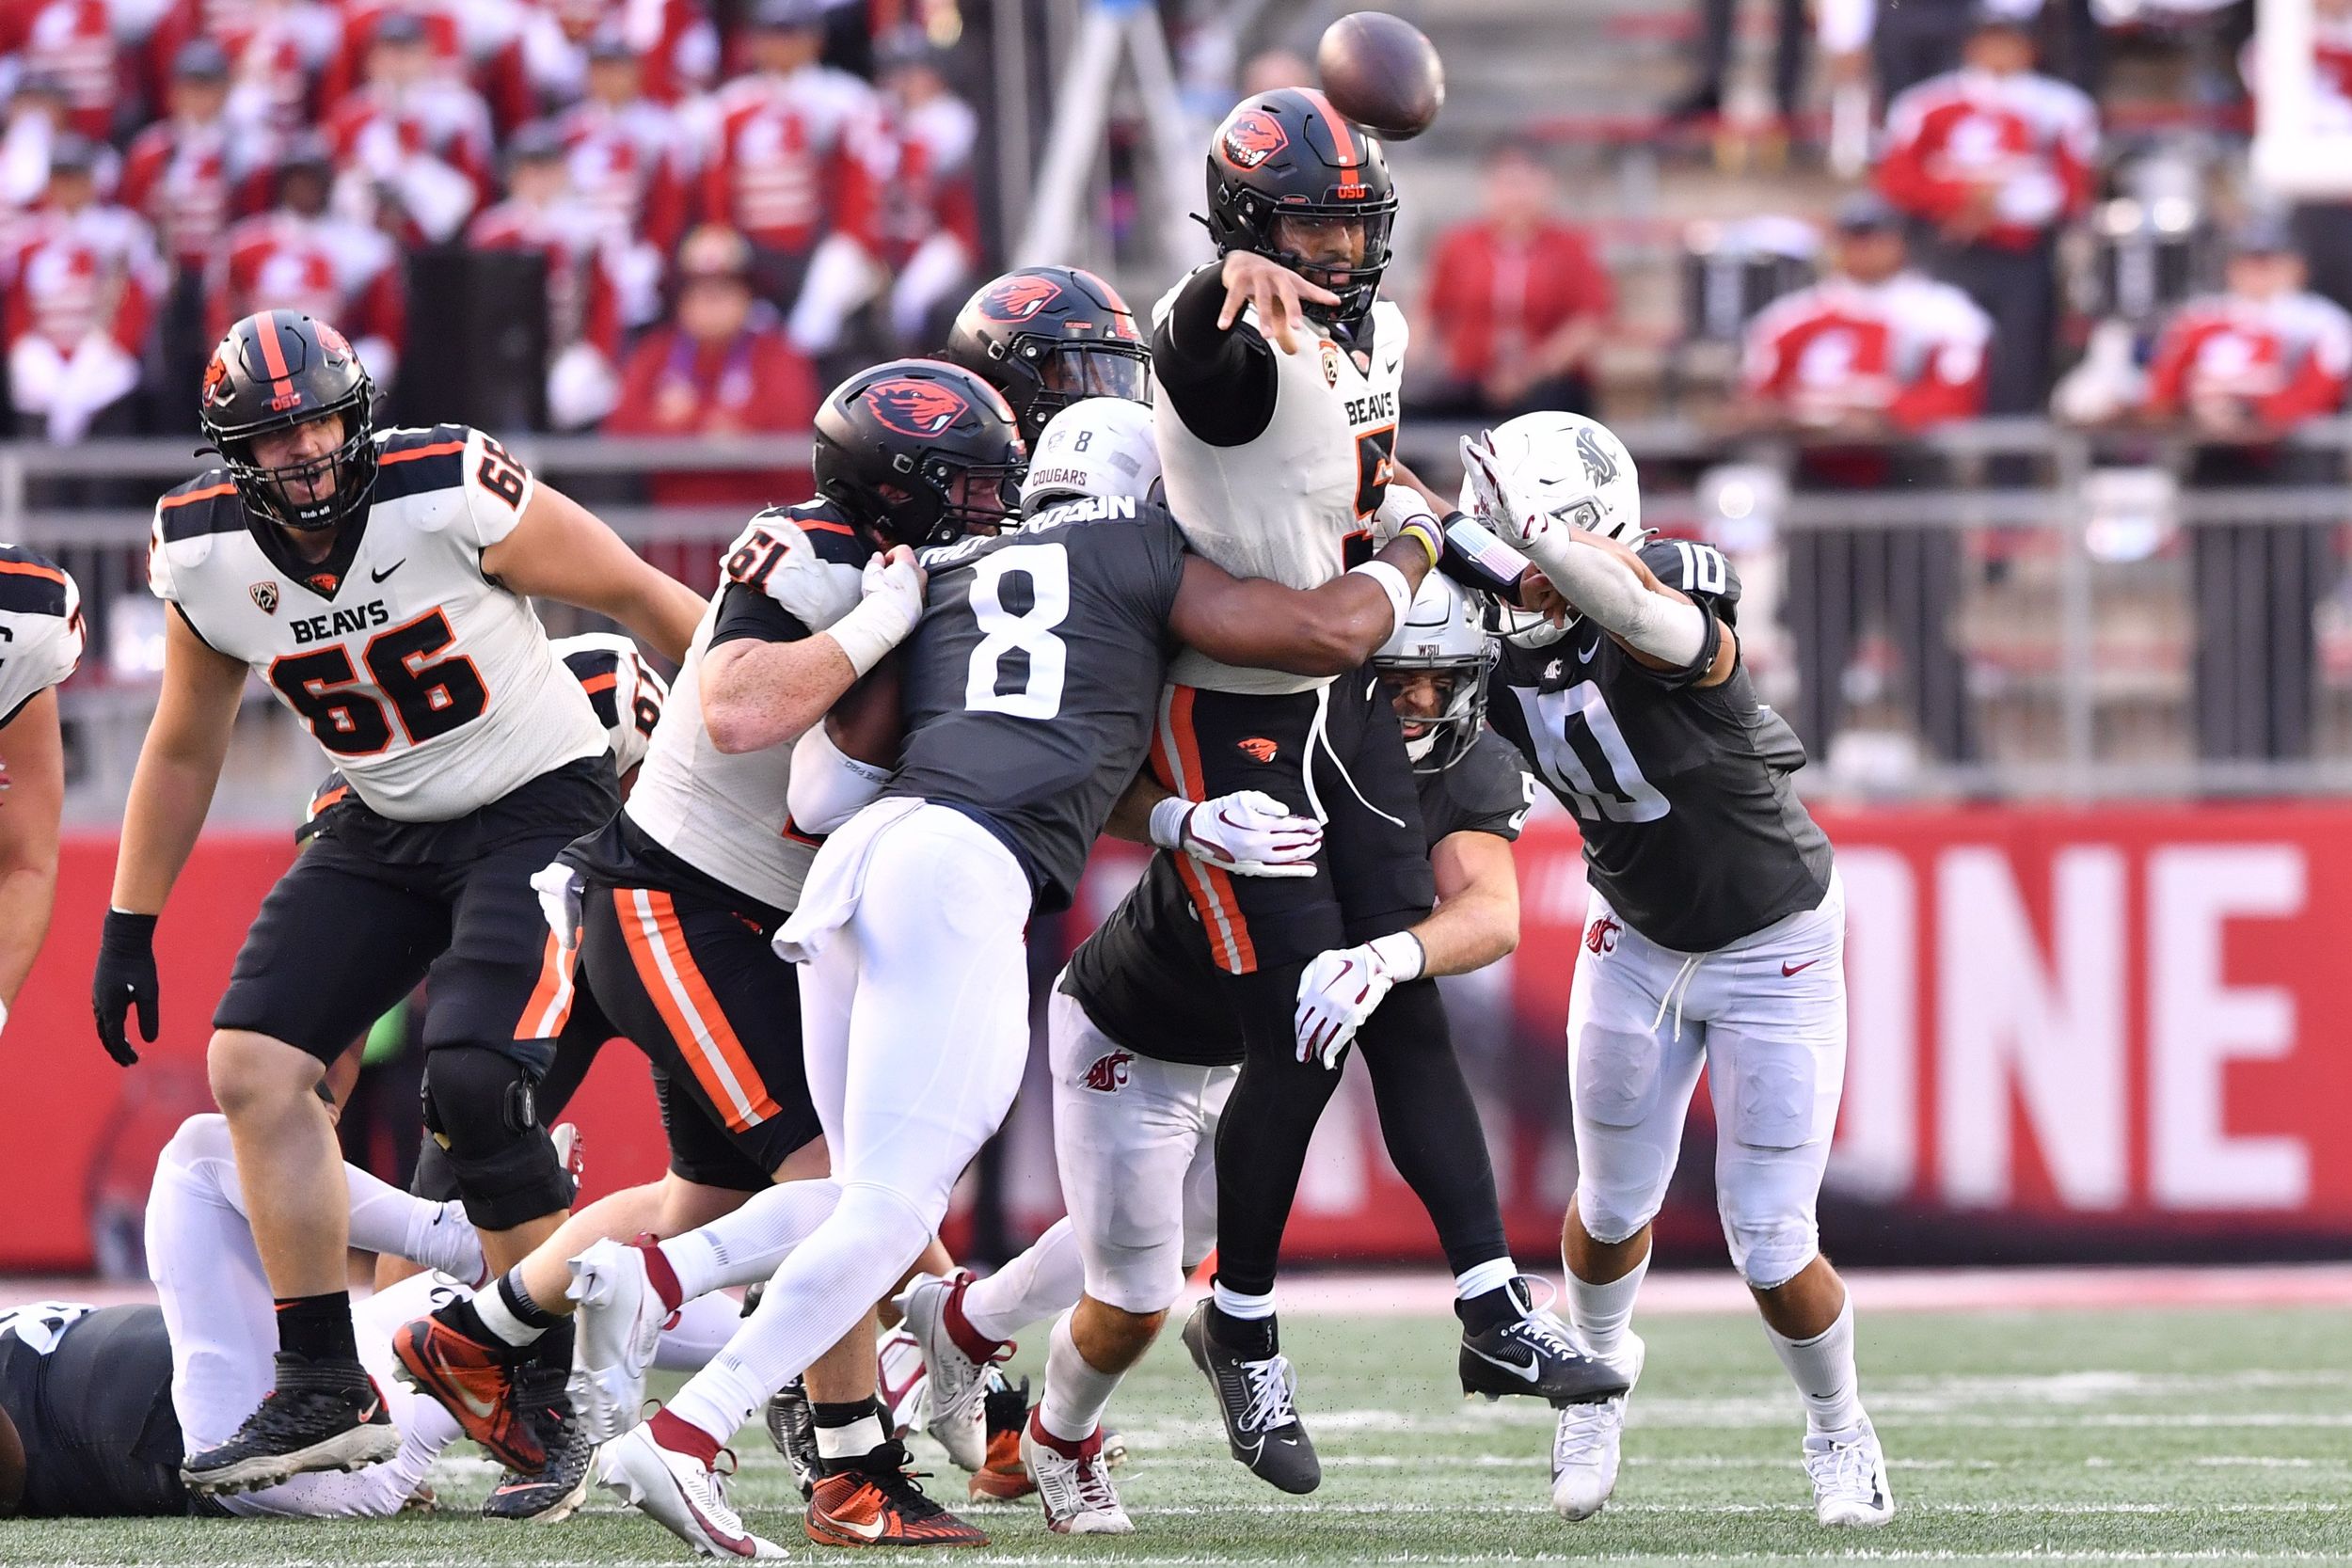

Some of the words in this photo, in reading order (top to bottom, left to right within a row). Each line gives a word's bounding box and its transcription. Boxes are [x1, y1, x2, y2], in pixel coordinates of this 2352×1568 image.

[1344, 391, 1394, 426] BEAVS
[1074, 430, 1093, 452] 8
[1032, 468, 1088, 487] COUGARS
[727, 529, 791, 593] 61
[1673, 541, 1726, 595] 10
[290, 599, 389, 644] BEAVS
[965, 542, 1070, 721] 8
[1418, 643, 1440, 656] WSU
[267, 605, 490, 756] 66
[1507, 679, 1672, 823] 10
